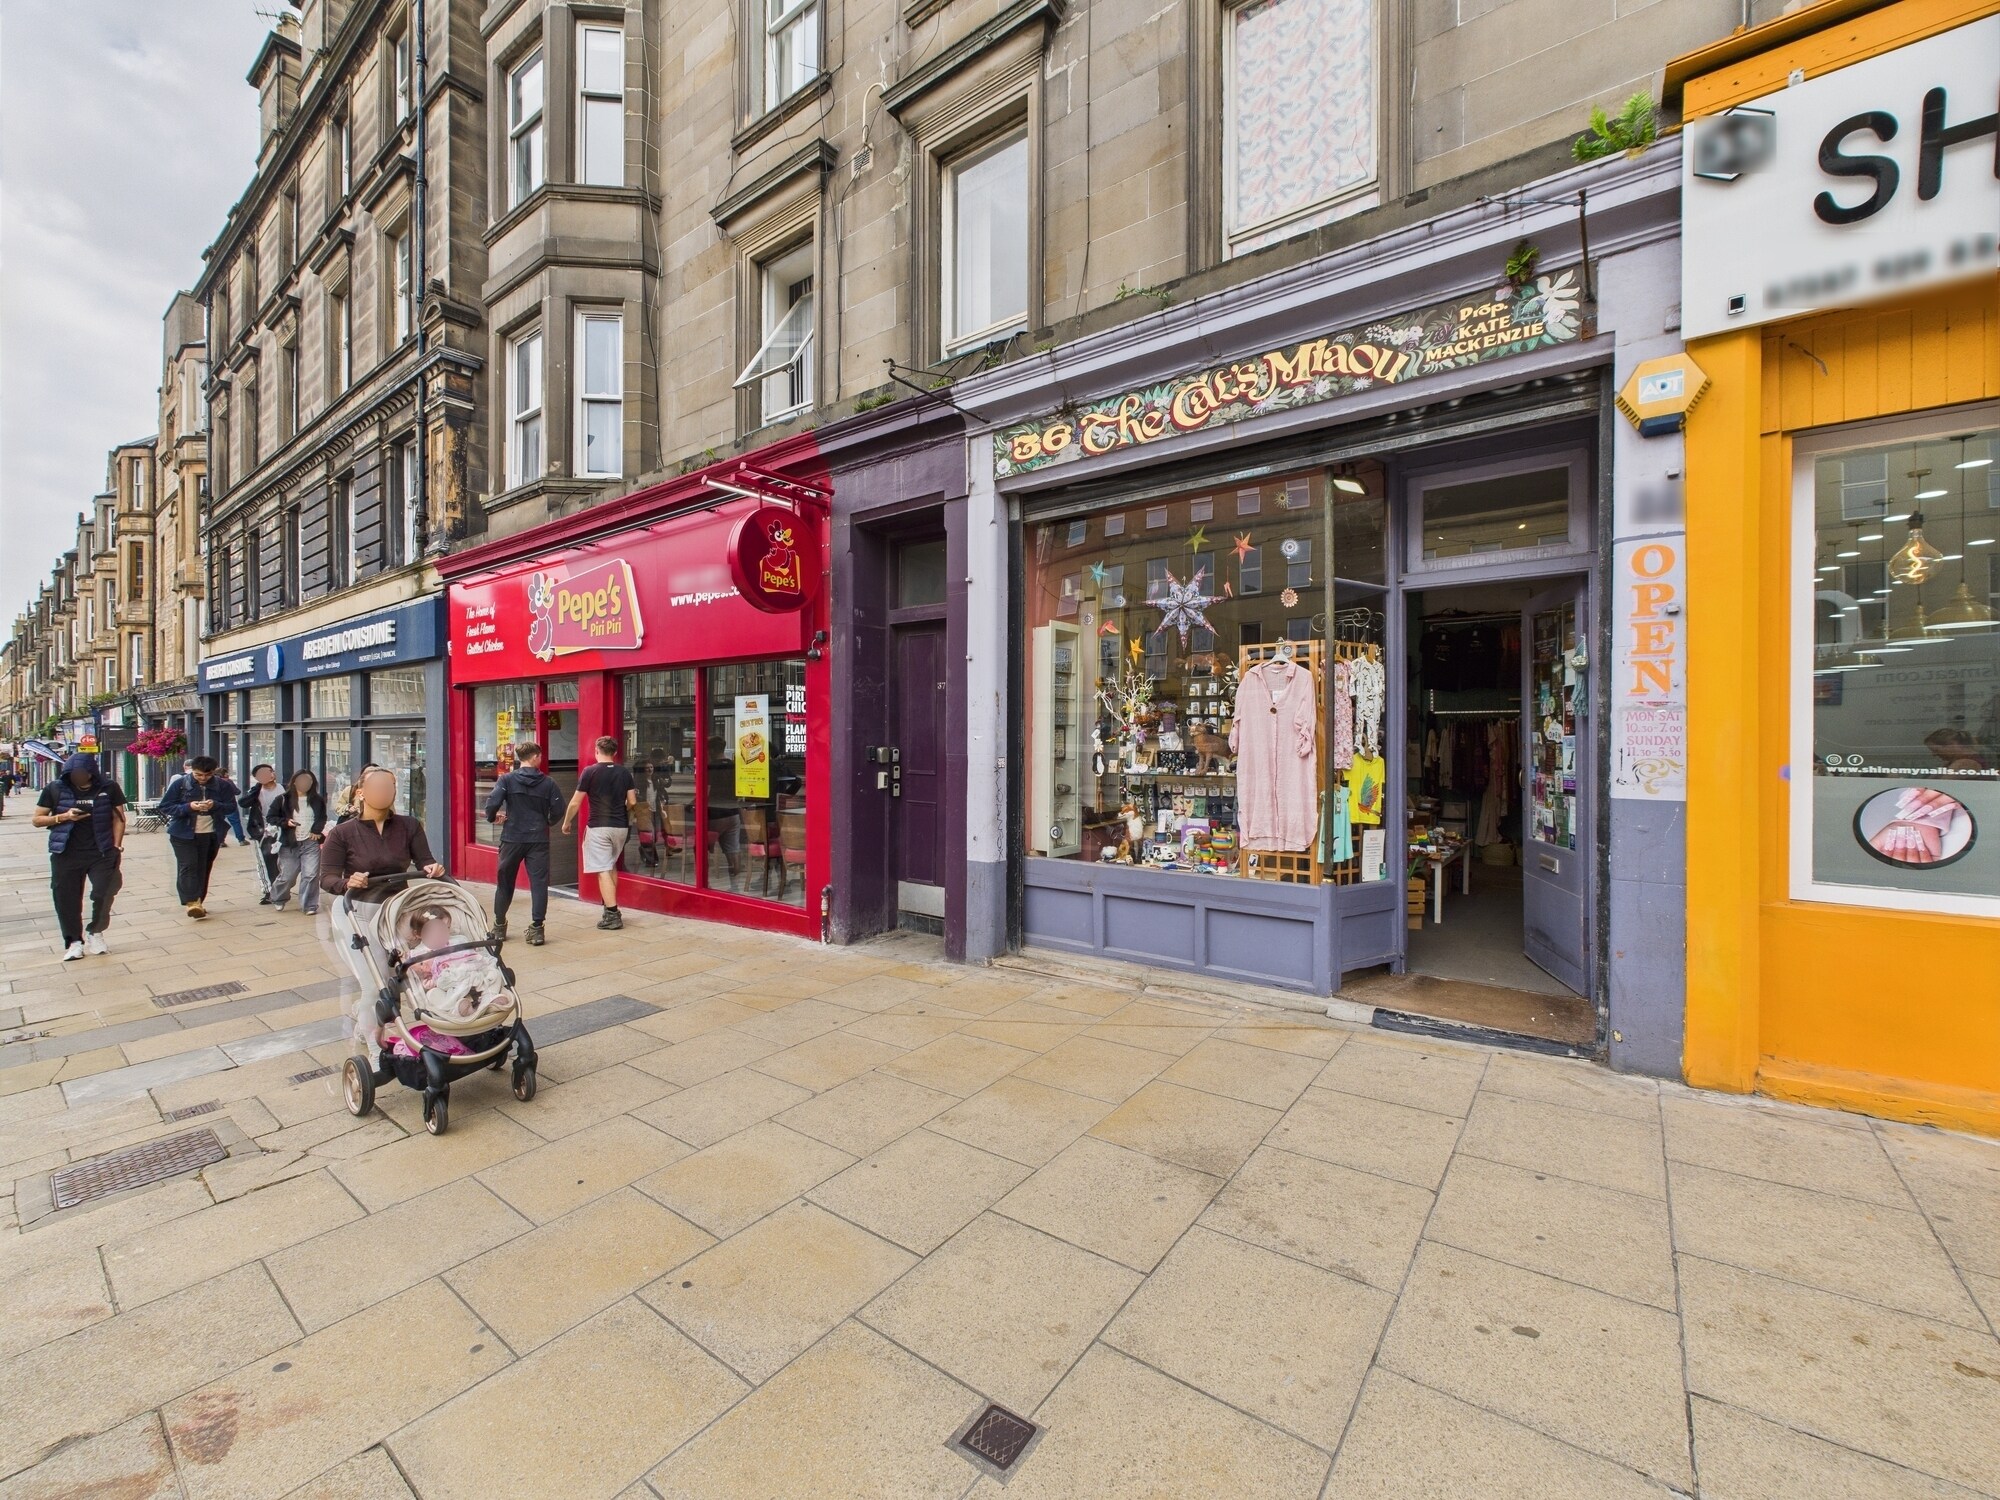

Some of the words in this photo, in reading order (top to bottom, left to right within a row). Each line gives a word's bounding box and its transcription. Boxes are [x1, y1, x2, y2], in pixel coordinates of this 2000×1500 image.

[1813, 86, 2000, 225] SH
[1459, 301, 1508, 324] Prop.
[1459, 315, 1512, 340] KATE
[1426, 322, 1545, 361] MACKENZIE
[1641, 375, 1683, 398] ADT
[1013, 425, 1072, 462] 36
[1081, 396, 1166, 455] The
[1171, 361, 1262, 429] Cat's
[1250, 338, 1410, 402] Miaou
[764, 571, 796, 588] Pepe's
[466, 606, 475, 619] The
[476, 605, 489, 618] Home
[489, 601, 496, 620] of
[558, 573, 622, 630] Pepe's
[590, 621, 605, 637] Piri
[606, 617, 622, 634] Piri
[1628, 543, 1676, 697] OPEN
[302, 633, 342, 660] ABERDEIN
[342, 620, 396, 652] CONSIDINE
[786, 691, 804, 701] PIRI
[786, 702, 806, 713] CHIC
[786, 744, 806, 753] PERFE
[1626, 736, 1681, 746] SUNDAY
[1826, 765, 2000, 776] www.shinemynails.co.uk
